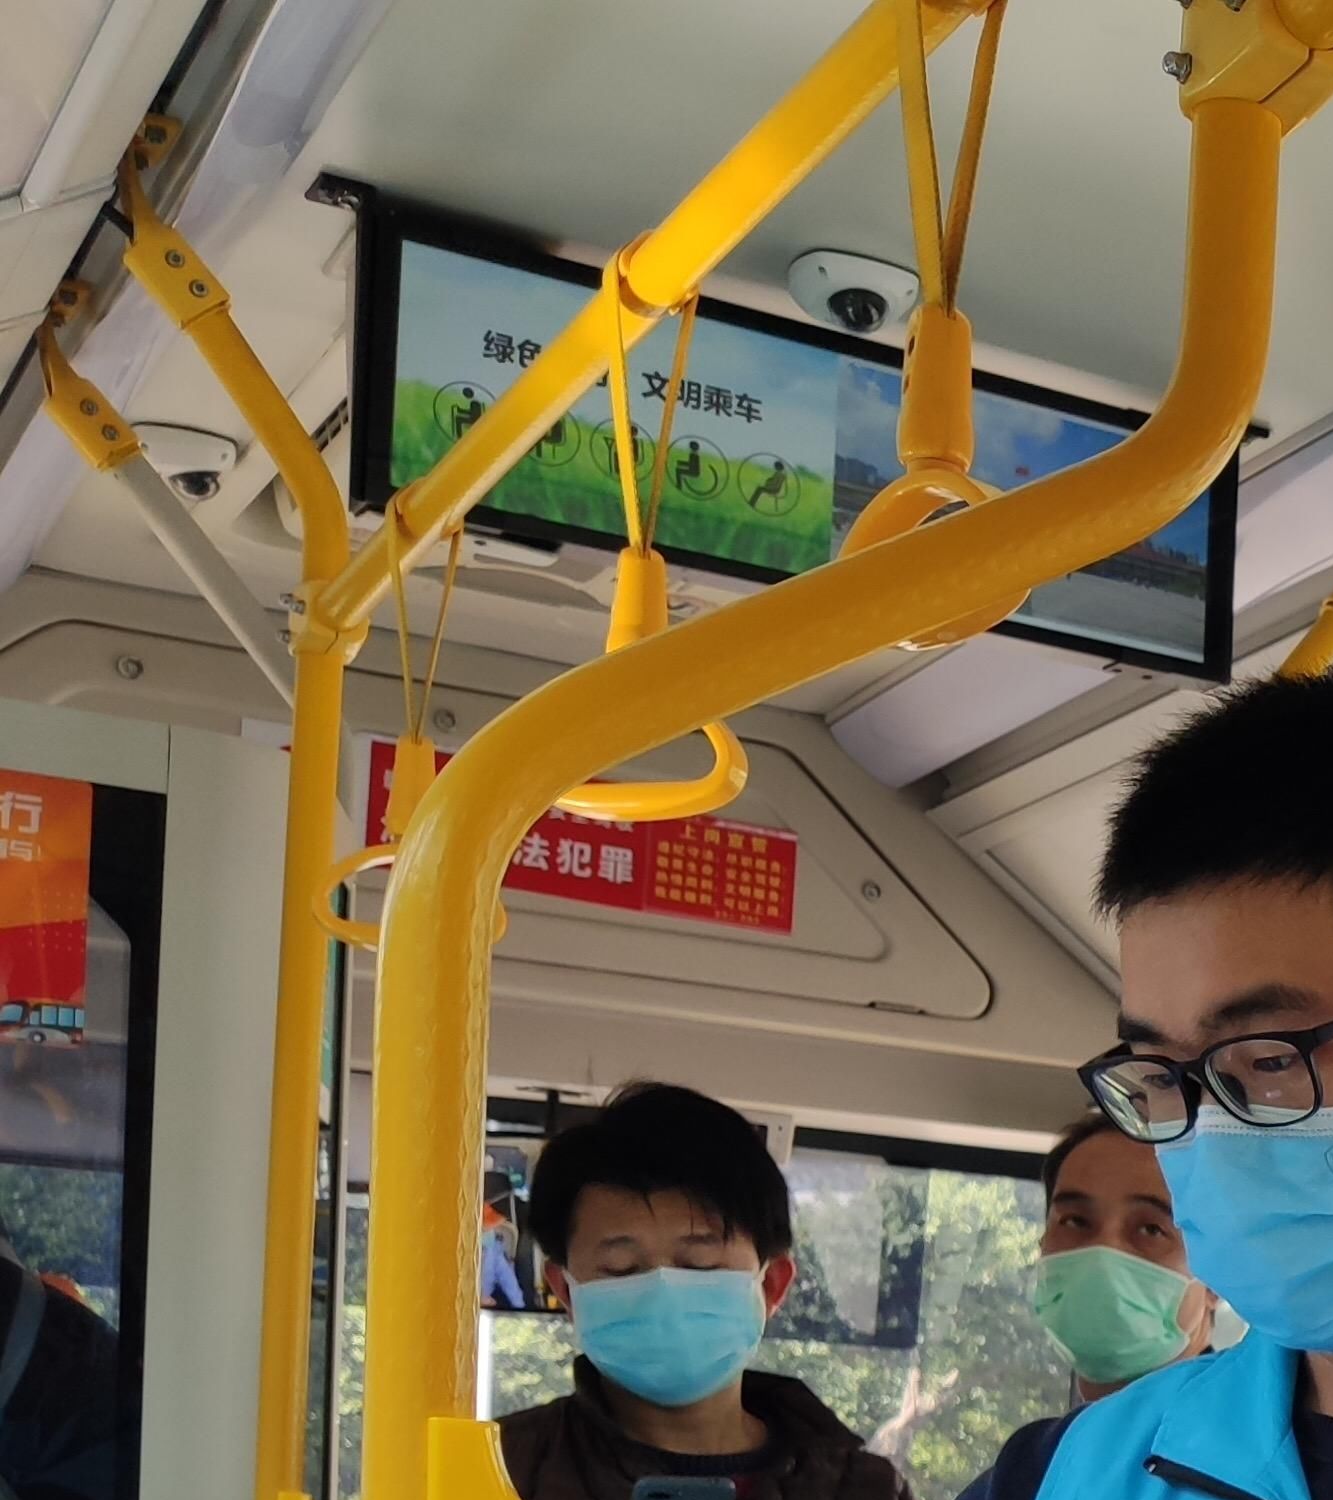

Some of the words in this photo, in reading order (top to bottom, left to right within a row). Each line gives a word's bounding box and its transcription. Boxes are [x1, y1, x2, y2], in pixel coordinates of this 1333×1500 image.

[641, 371, 763, 424] 文明乘车
[511, 832, 635, 885] 法犯罪
